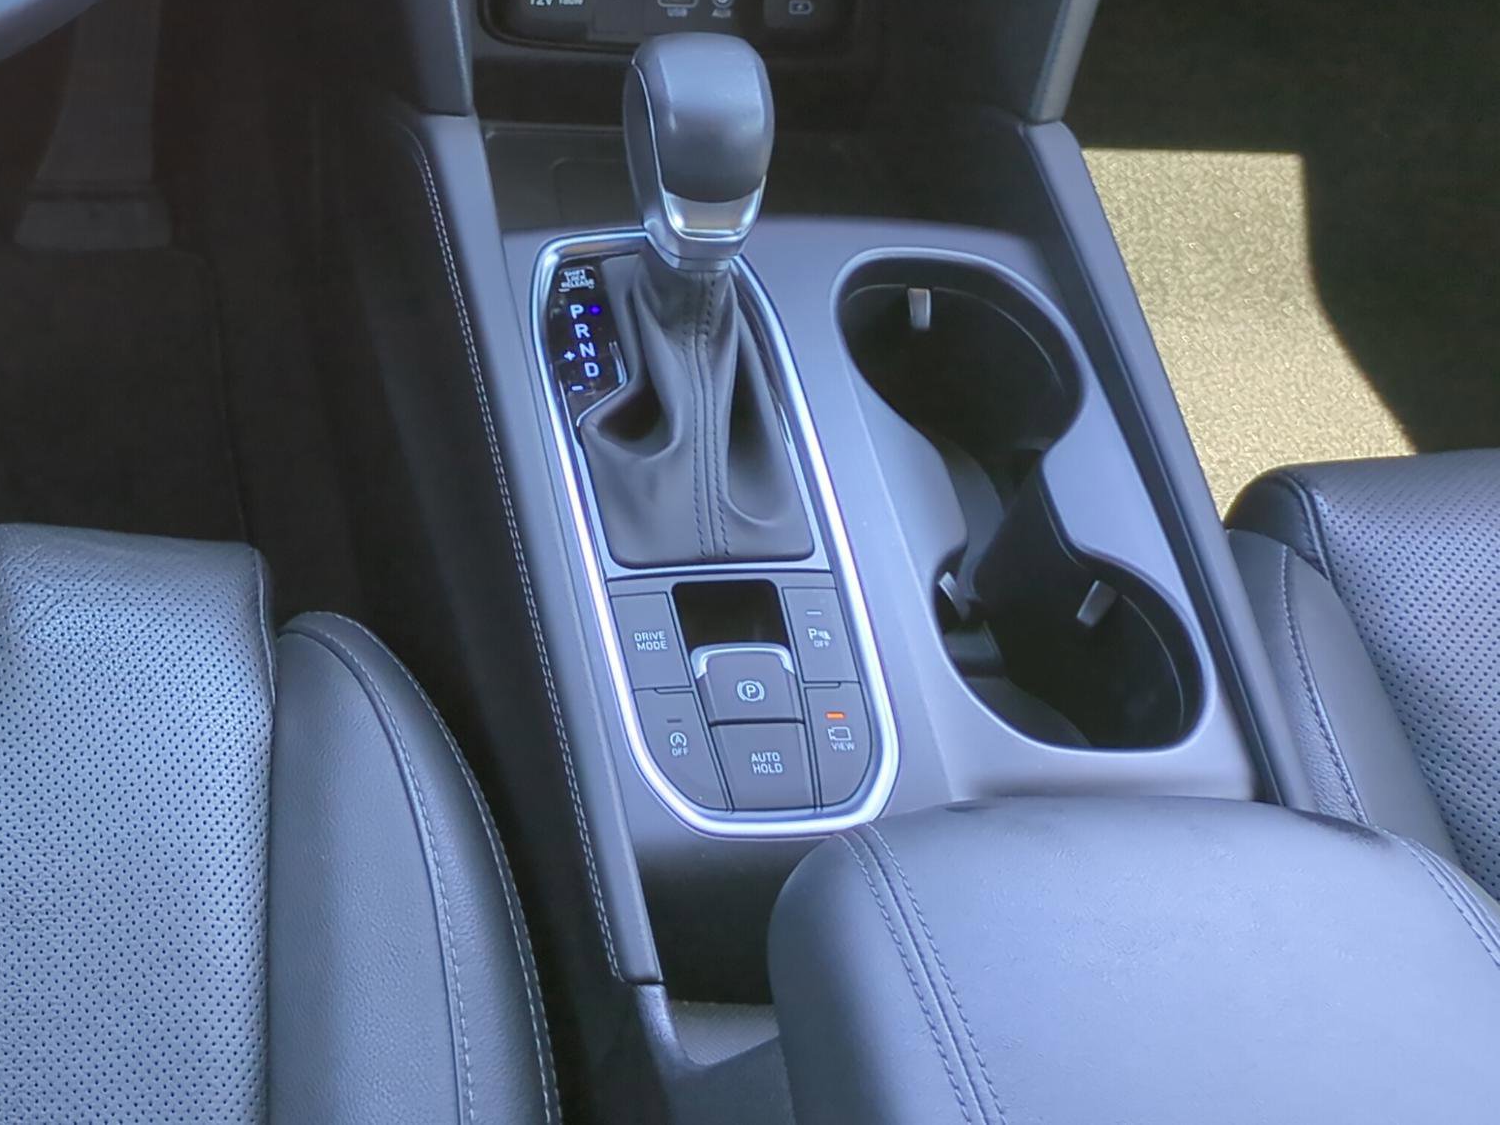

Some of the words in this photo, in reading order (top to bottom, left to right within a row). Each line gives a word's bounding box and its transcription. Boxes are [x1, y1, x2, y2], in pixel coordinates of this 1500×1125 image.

[570, 304, 584, 319] P
[575, 324, 590, 338] R
[579, 343, 596, 358] N
[584, 362, 600, 377] D
[634, 631, 666, 642] DRIVE
[808, 628, 818, 641] P
[637, 640, 668, 651] MODE
[814, 638, 830, 648] OFF
[746, 684, 756, 697] P
[672, 747, 688, 756] OFF
[831, 741, 855, 751] VIEW
[751, 752, 781, 763] AUTO
[753, 762, 783, 773] HOLD
